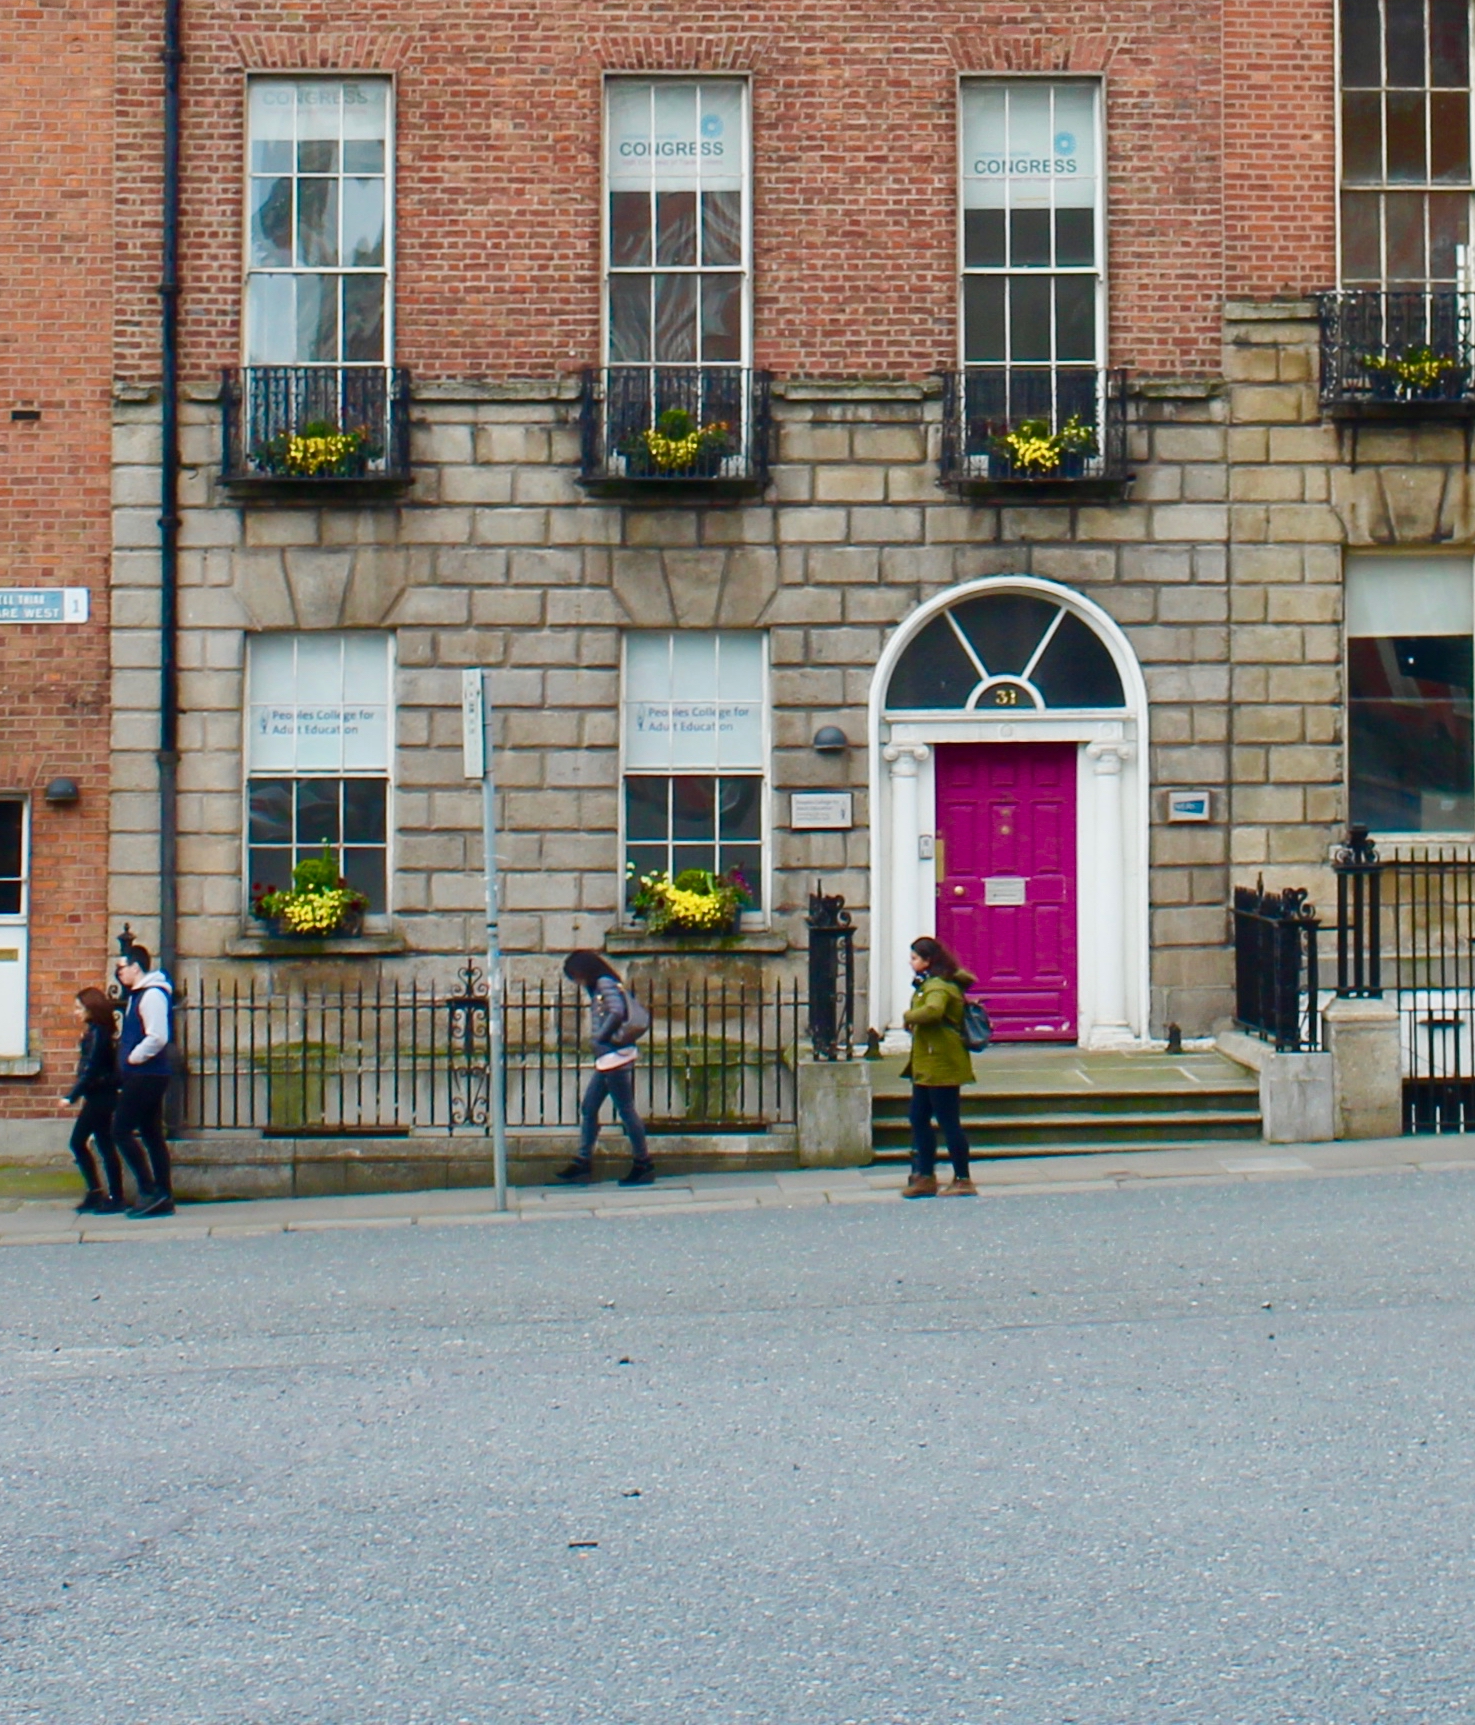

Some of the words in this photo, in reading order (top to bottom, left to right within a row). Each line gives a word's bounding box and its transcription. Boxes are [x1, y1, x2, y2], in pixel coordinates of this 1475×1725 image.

[620, 141, 724, 156] CONGRESS
[974, 159, 1077, 174] CONGRESS
[73, 600, 79, 613] 1
[24, 608, 60, 618] WEST
[272, 710, 314, 722] Peoles
[359, 709, 374, 720] for
[649, 708, 689, 719] Peoles
[734, 707, 749, 717] for
[272, 725, 301, 734] Adut
[305, 724, 358, 734] Educaton
[649, 722, 678, 731] Adut
[681, 721, 733, 731] Educaton
